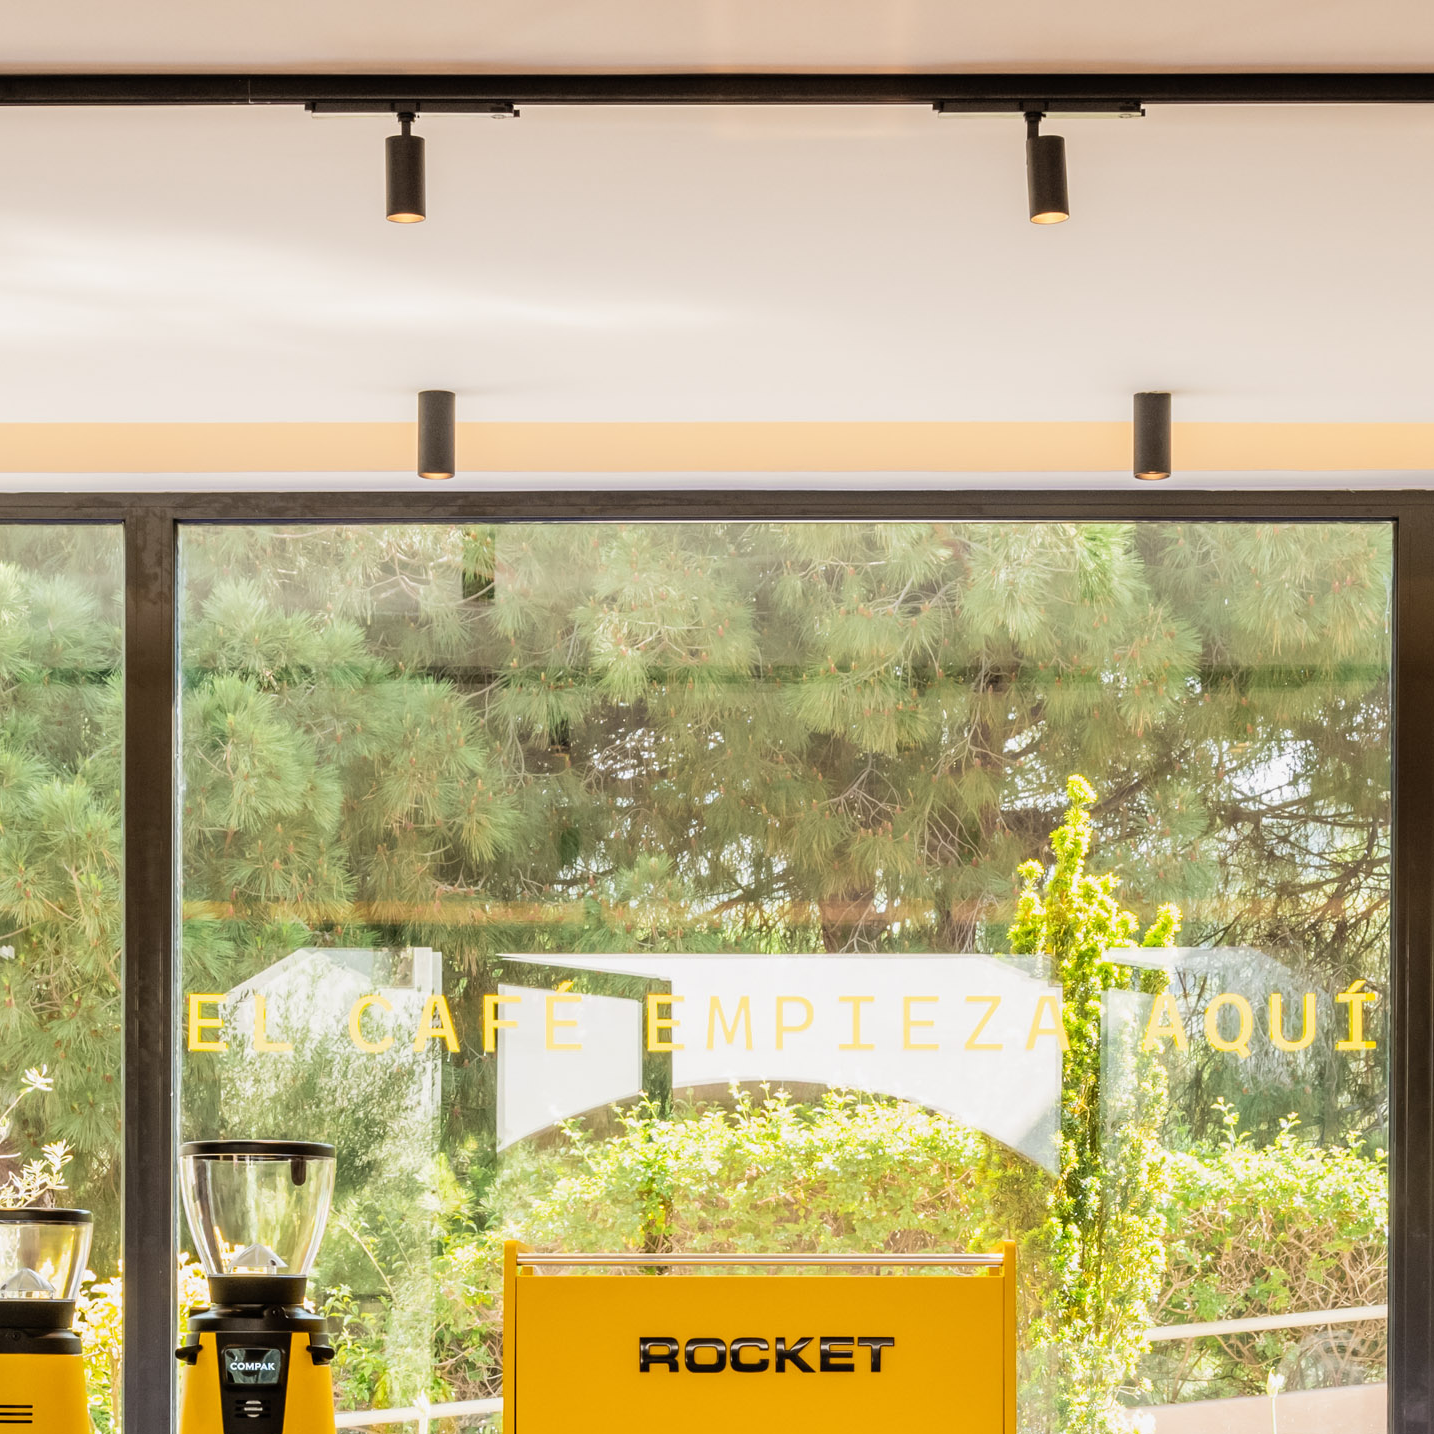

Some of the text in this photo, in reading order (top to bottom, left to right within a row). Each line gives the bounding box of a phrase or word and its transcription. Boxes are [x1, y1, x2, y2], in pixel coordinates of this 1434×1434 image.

[187, 979, 1378, 1058] EL CAFÉ EMPIEZA AQUÍ
[229, 1362, 276, 1371] COMPAK
[639, 1336, 895, 1373] ROCKET
